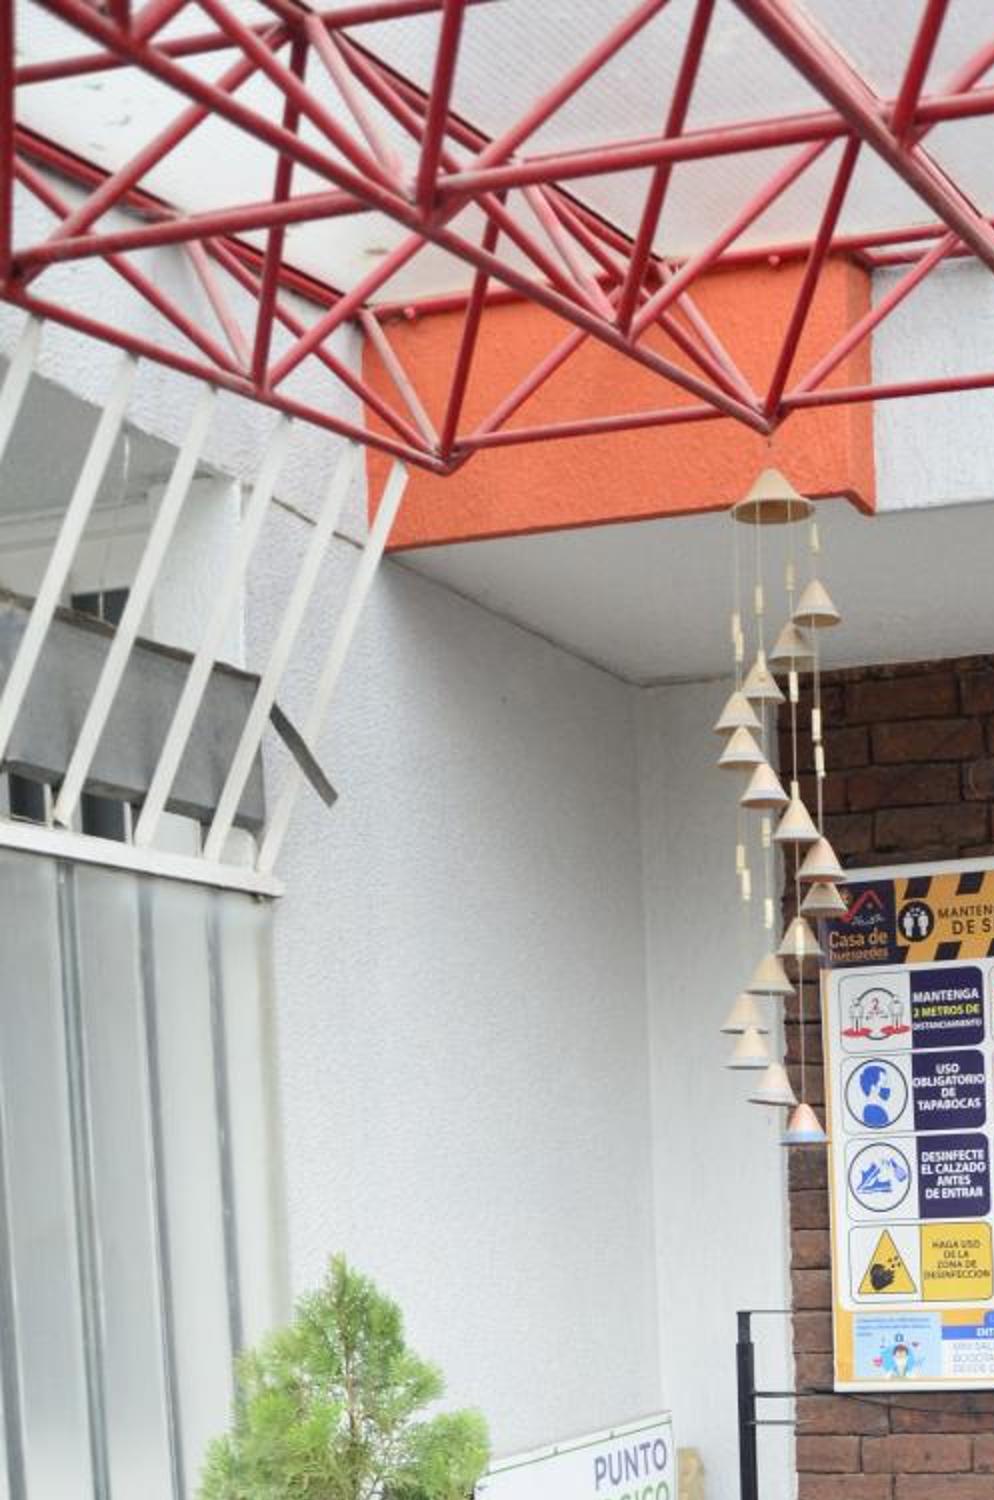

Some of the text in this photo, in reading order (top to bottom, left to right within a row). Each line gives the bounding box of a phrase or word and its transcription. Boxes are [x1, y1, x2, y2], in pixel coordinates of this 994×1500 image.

[952, 919, 976, 935] DE
[829, 927, 888, 948] Casa de
[913, 987, 979, 1003] MANTENGA
[921, 1004, 963, 1017] METROS
[965, 1003, 980, 1014] DE
[935, 1063, 960, 1074] USO
[912, 1073, 985, 1087] OBLIGATORIO
[941, 1087, 956, 1098] DE
[917, 1097, 982, 1111] TAPABOCAS
[921, 1150, 984, 1162] DESINFECTE
[921, 1162, 986, 1175] EL CALZADO
[937, 1174, 972, 1186] ANTES
[925, 1186, 983, 1199] DE ENTRAR
[932, 1240, 980, 1249] HAGA USO
[943, 1250, 969, 1259] DE LA
[937, 1260, 962, 1269] ZONA
[594, 1438, 668, 1491] PUNTO
